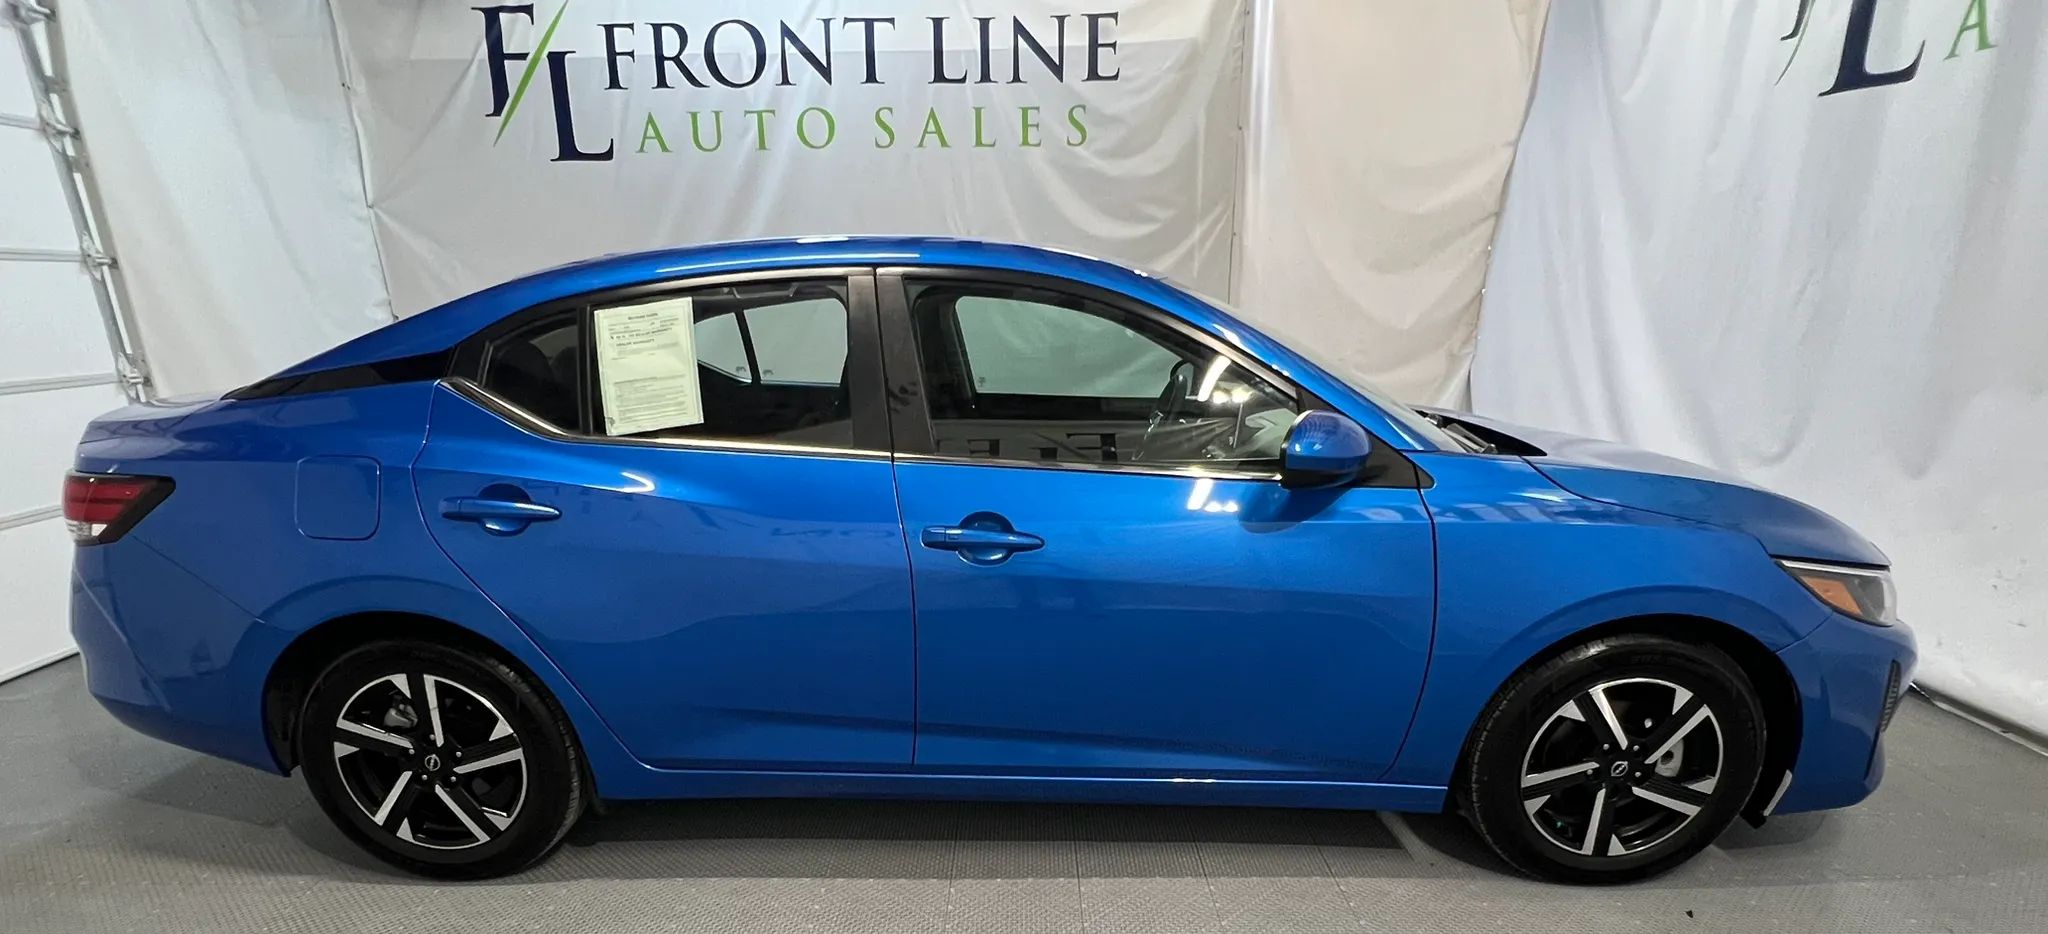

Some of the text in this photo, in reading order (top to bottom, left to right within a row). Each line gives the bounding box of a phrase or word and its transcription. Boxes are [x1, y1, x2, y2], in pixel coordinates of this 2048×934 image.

[596, 12, 1121, 91] FRONT LINE
[635, 104, 1089, 153] AUTO SALES
